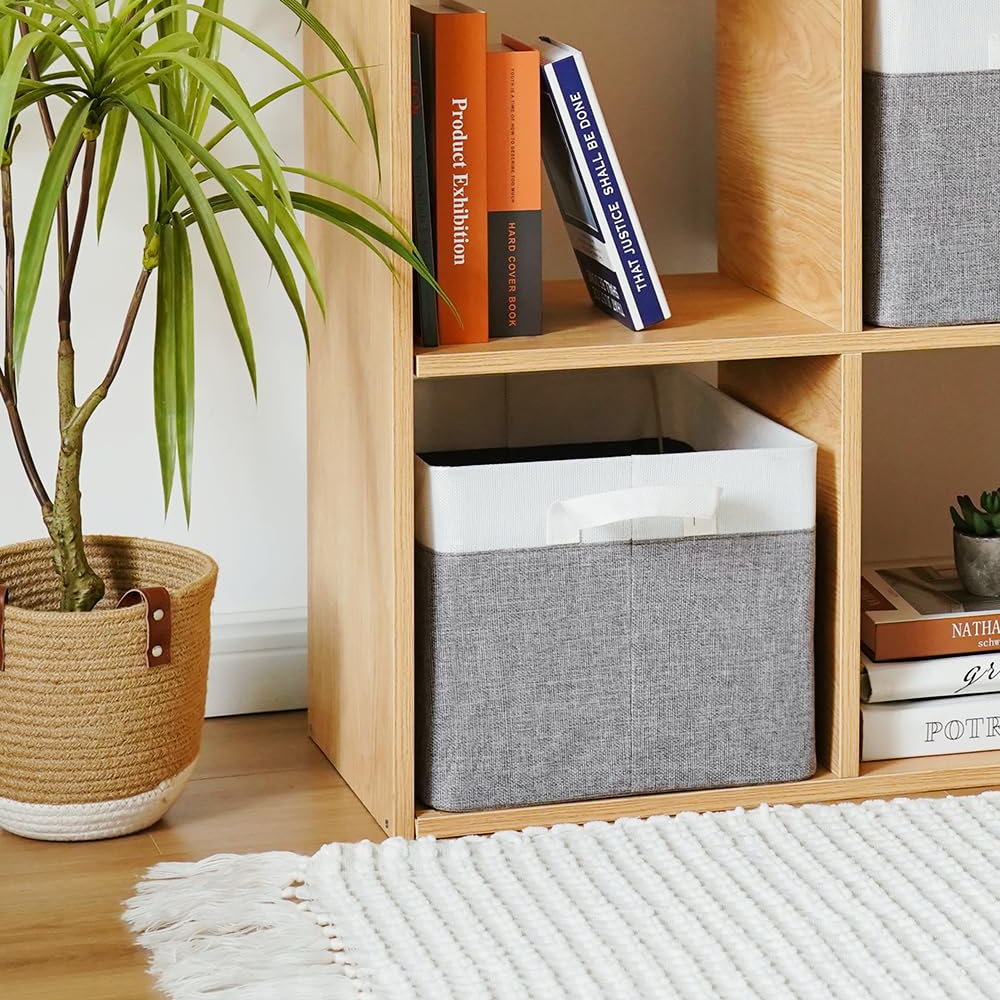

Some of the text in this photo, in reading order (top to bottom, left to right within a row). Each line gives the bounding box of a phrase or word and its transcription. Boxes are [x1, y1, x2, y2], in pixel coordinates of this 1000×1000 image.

[570, 91, 591, 129] DONE
[583, 133, 599, 151] BE
[451, 97, 470, 266] Product Exhibition
[592, 153, 614, 196] SHALL
[608, 202, 637, 256] JUSTICE
[508, 222, 517, 327] HARD COVER BOOK
[627, 259, 647, 292] THAT
